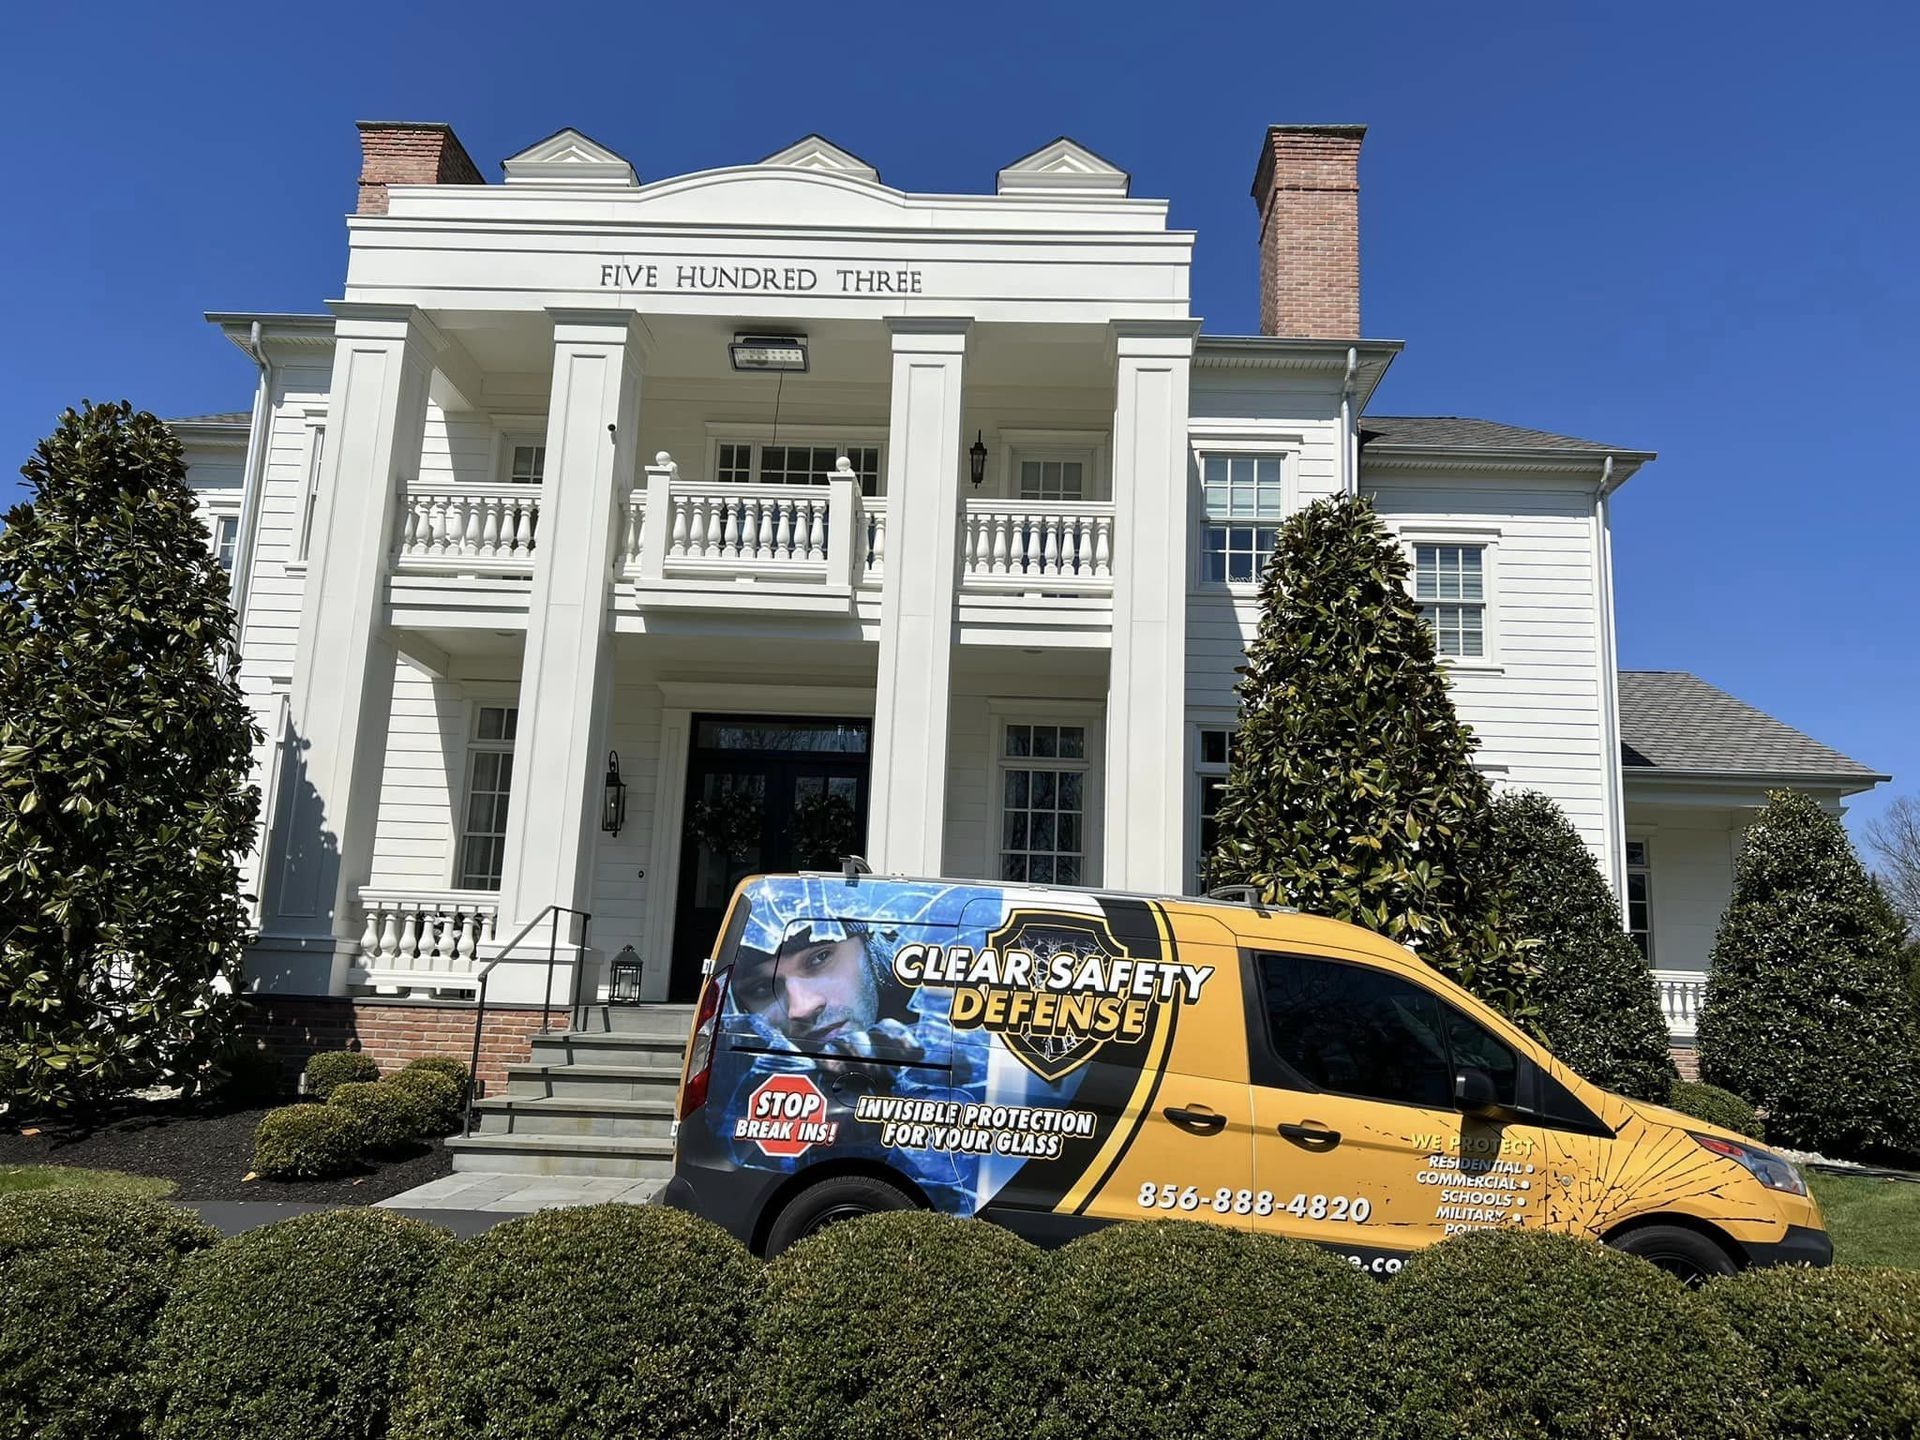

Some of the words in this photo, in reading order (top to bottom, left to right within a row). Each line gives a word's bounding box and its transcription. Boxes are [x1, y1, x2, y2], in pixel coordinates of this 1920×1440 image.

[600, 264, 657, 288] FIVE
[676, 266, 817, 291] HUNDRED
[836, 269, 922, 294] THREE
[893, 945, 1032, 988] CLEAR
[1046, 953, 1216, 1003] SAFETY
[951, 988, 1148, 1040] DEFENSE
[756, 1091, 820, 1118] STOP
[857, 1097, 958, 1126] INVISIBLE
[963, 1104, 1095, 1136] PROTECTION
[735, 1120, 795, 1141] BREAK
[798, 1123, 837, 1144] INS!
[884, 1122, 926, 1148] FOR
[934, 1126, 991, 1151] YOUR
[996, 1131, 1060, 1157] GLASS
[1410, 1133, 1442, 1151] WE
[1449, 1137, 1534, 1157] PROTECT
[1428, 1155, 1523, 1175] RESIDENTIAL
[1416, 1170, 1518, 1190] COMMERCIAL
[1137, 1182, 1372, 1223] 856-888-4820
[1440, 1189, 1512, 1208] SCHOOLS
[1435, 1206, 1506, 1222] MILITARY
